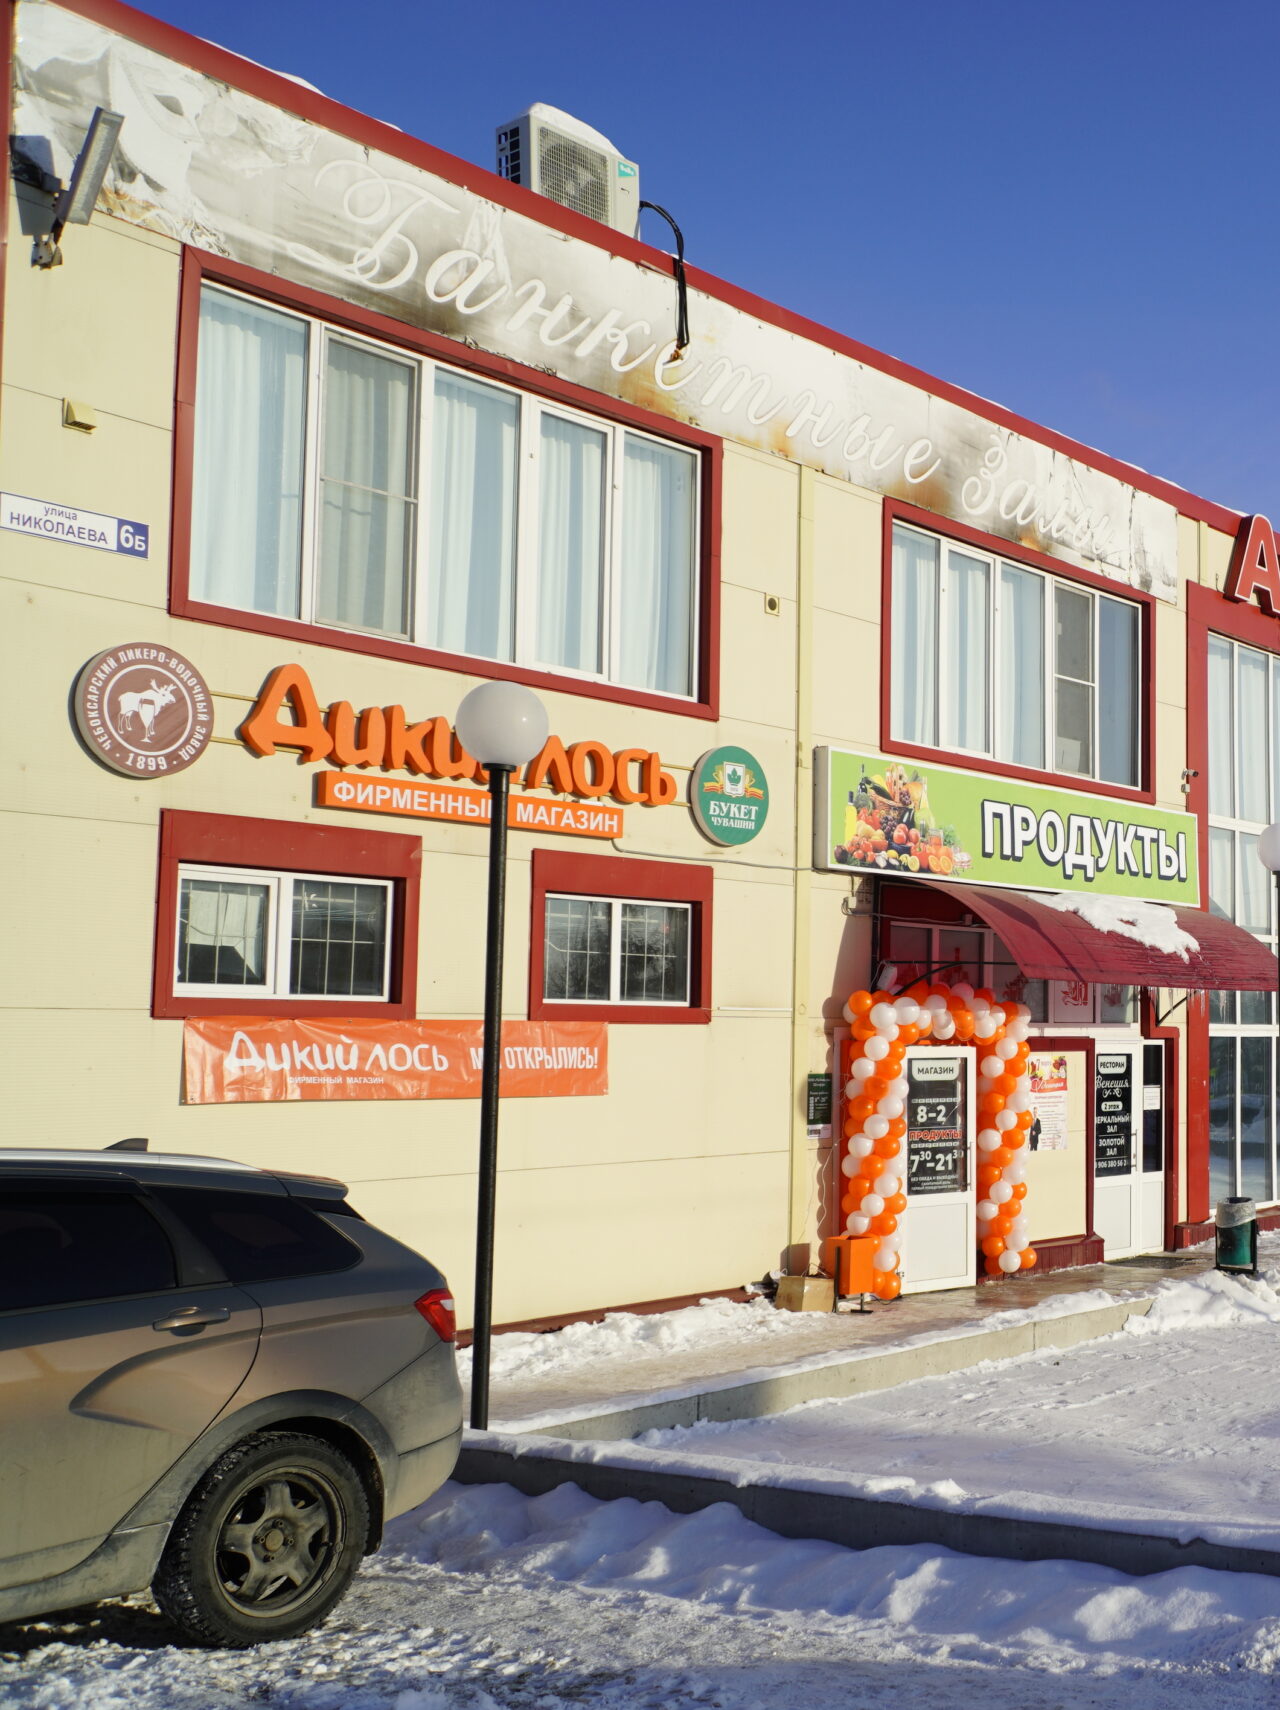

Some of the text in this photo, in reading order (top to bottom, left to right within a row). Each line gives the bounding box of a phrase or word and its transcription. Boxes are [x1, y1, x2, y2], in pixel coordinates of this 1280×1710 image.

[284, 158, 941, 485] Банкетные
[44, 506, 78, 521] улица
[10, 512, 147, 552] НИКОЛАЕВА 6Б
[86, 648, 210, 761] ЧЕБОКСАРСКИЙ ЛИКЕРО-ВОДОЧНЫЙ ЗАВОД
[240, 663, 521, 785] Дики
[125, 753, 168, 771] 1899
[333, 780, 620, 834] ФИРМЕННЫ МАГАЗИН
[708, 800, 759, 820] БУКЕТ
[981, 799, 1189, 882] ПРОДУКТЫ
[224, 1031, 359, 1072] Дикий
[365, 1043, 449, 1071] лось
[504, 1046, 598, 1070] ОТКРЫЛИСЬ!
[917, 1066, 954, 1075] МАГАЗИН
[1099, 1061, 1125, 1069] РЕСТОРАН
[288, 1075, 385, 1085] ФИРМЕННЫЙ МАГАЗИН
[1096, 1075, 1130, 1089] Венеция
[1096, 1113, 1130, 1124] ЕРКАЛЬНЫЙ
[908, 1129, 963, 1141] ПРОДУКТЫ
[1106, 1125, 1118, 1133] ЗАЛ
[1099, 1136, 1125, 1146] ЗОЛОТОЙ
[1106, 1148, 1118, 1156] ЗАЛ
